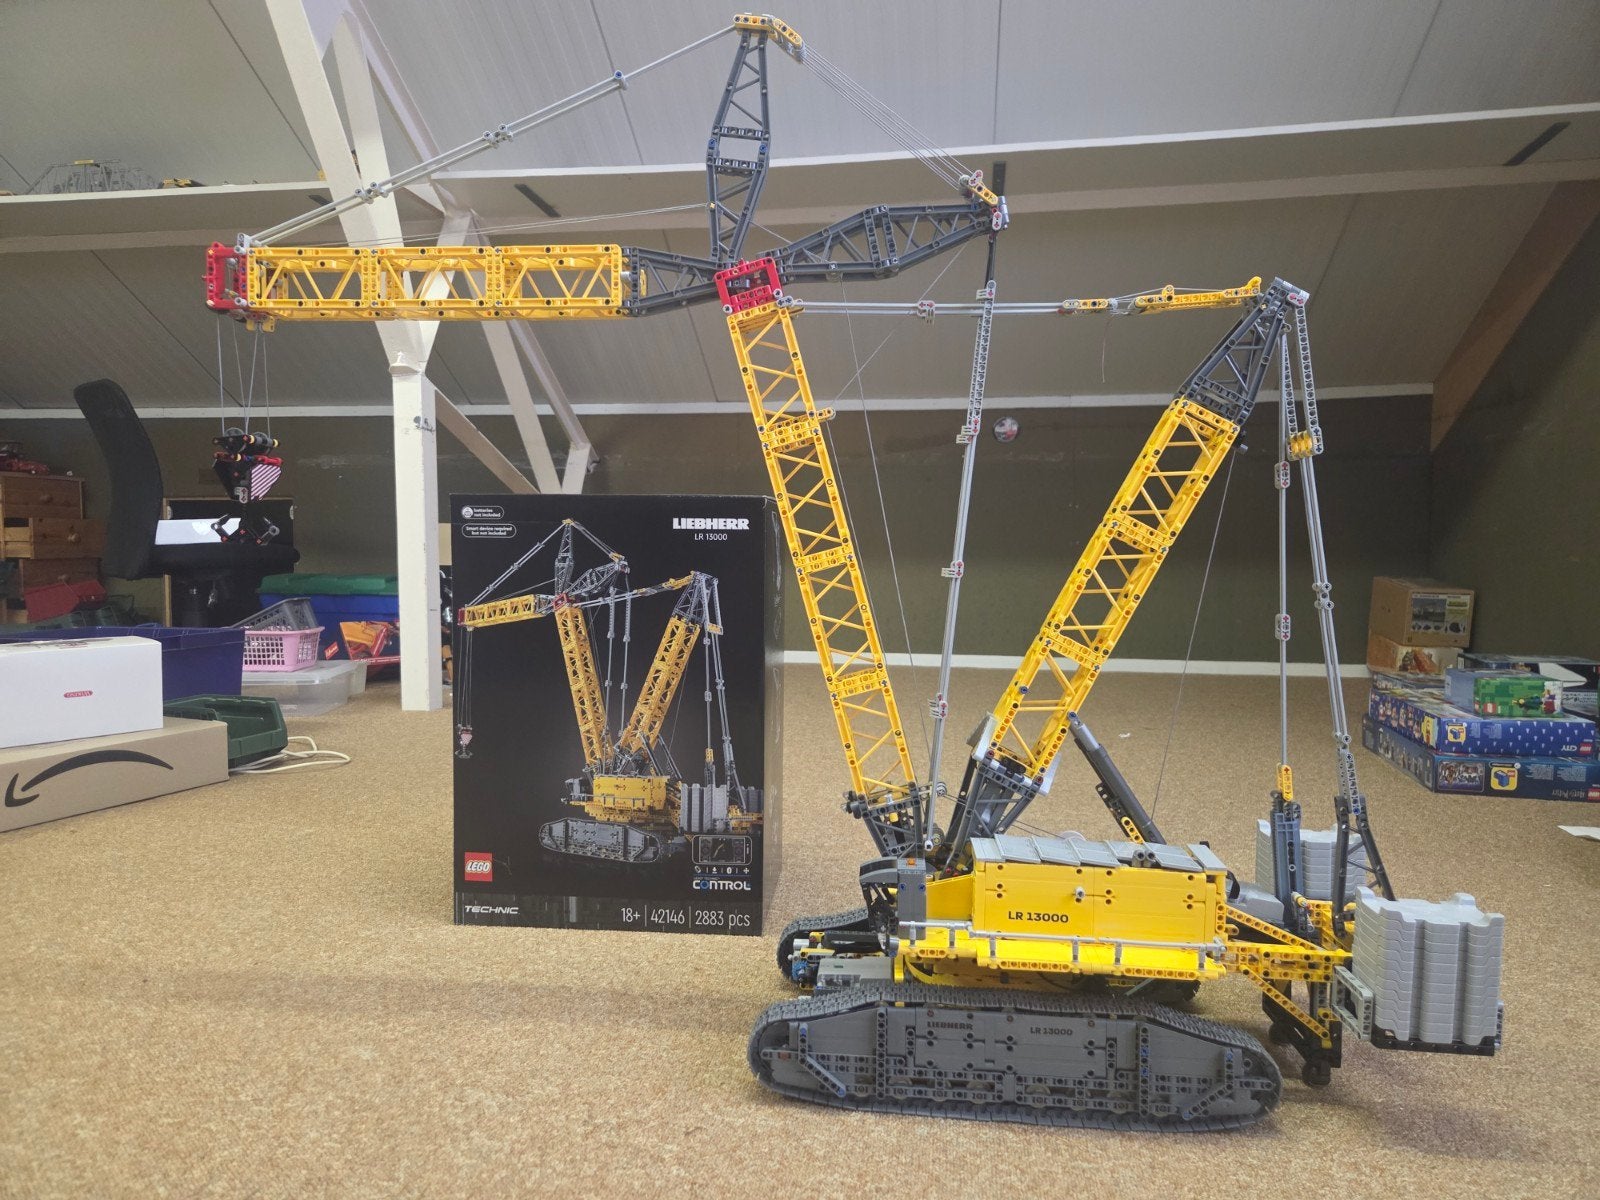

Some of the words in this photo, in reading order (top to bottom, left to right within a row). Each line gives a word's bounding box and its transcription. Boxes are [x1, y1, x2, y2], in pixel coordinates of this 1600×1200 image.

[673, 517, 750, 530] LIEBHERR
[706, 533, 728, 541] 13000
[466, 860, 491, 872] LEGO
[465, 905, 519, 914] TECHNIC
[621, 907, 640, 922] 18+
[650, 908, 685, 924] 42146
[695, 910, 724, 926] 2883
[728, 913, 751, 930] pcs
[1008, 911, 1024, 920] LR
[1027, 912, 1069, 923] 13000
[927, 1021, 973, 1030] LIEBHERR
[1043, 1027, 1073, 1036] 13000
